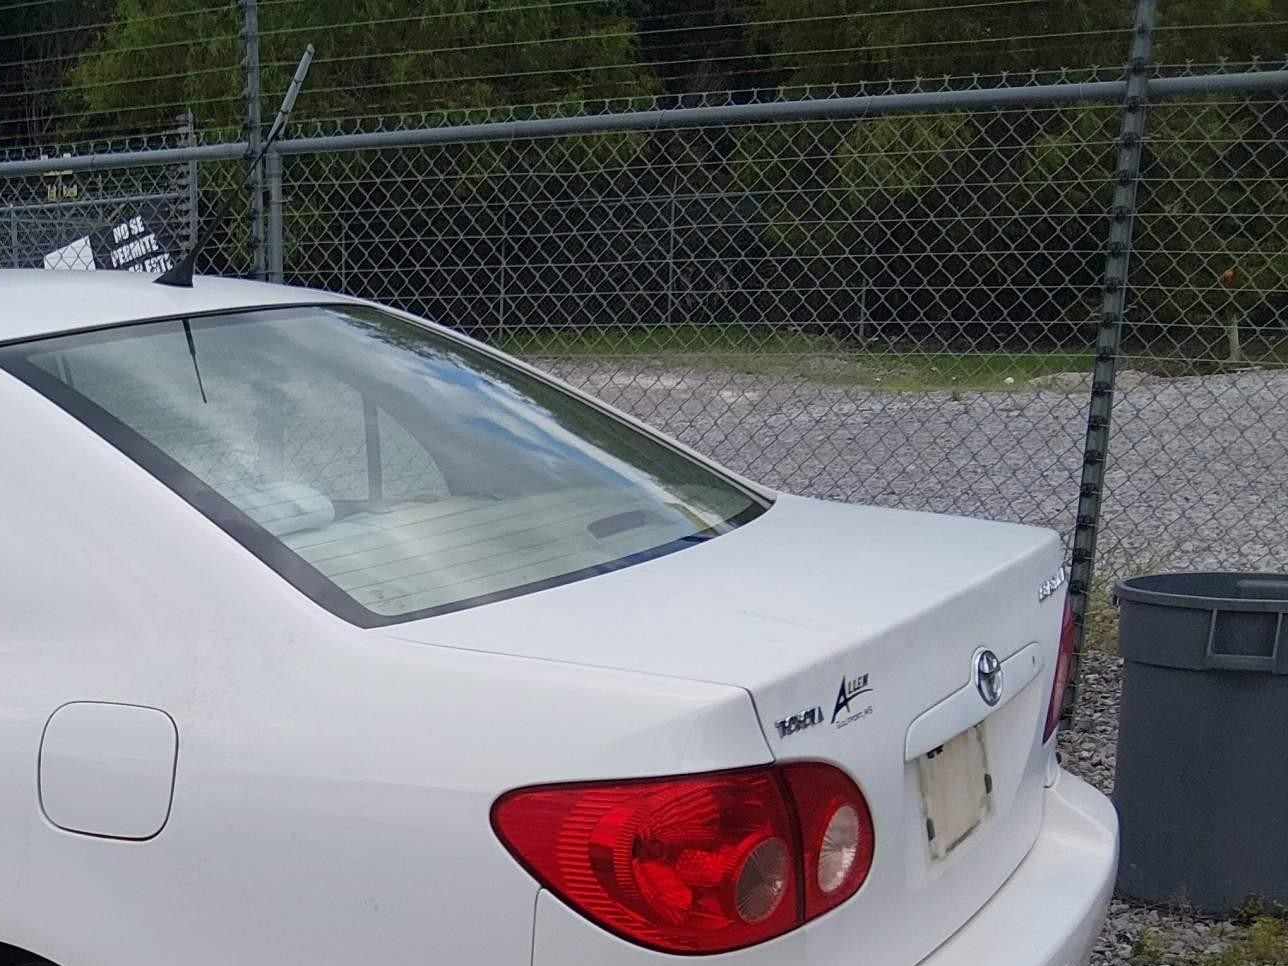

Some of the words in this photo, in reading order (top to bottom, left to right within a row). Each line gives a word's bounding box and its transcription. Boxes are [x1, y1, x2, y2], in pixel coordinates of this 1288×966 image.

[112, 223, 129, 243] NO
[129, 215, 145, 235] SE
[110, 233, 159, 268] PERMITE
